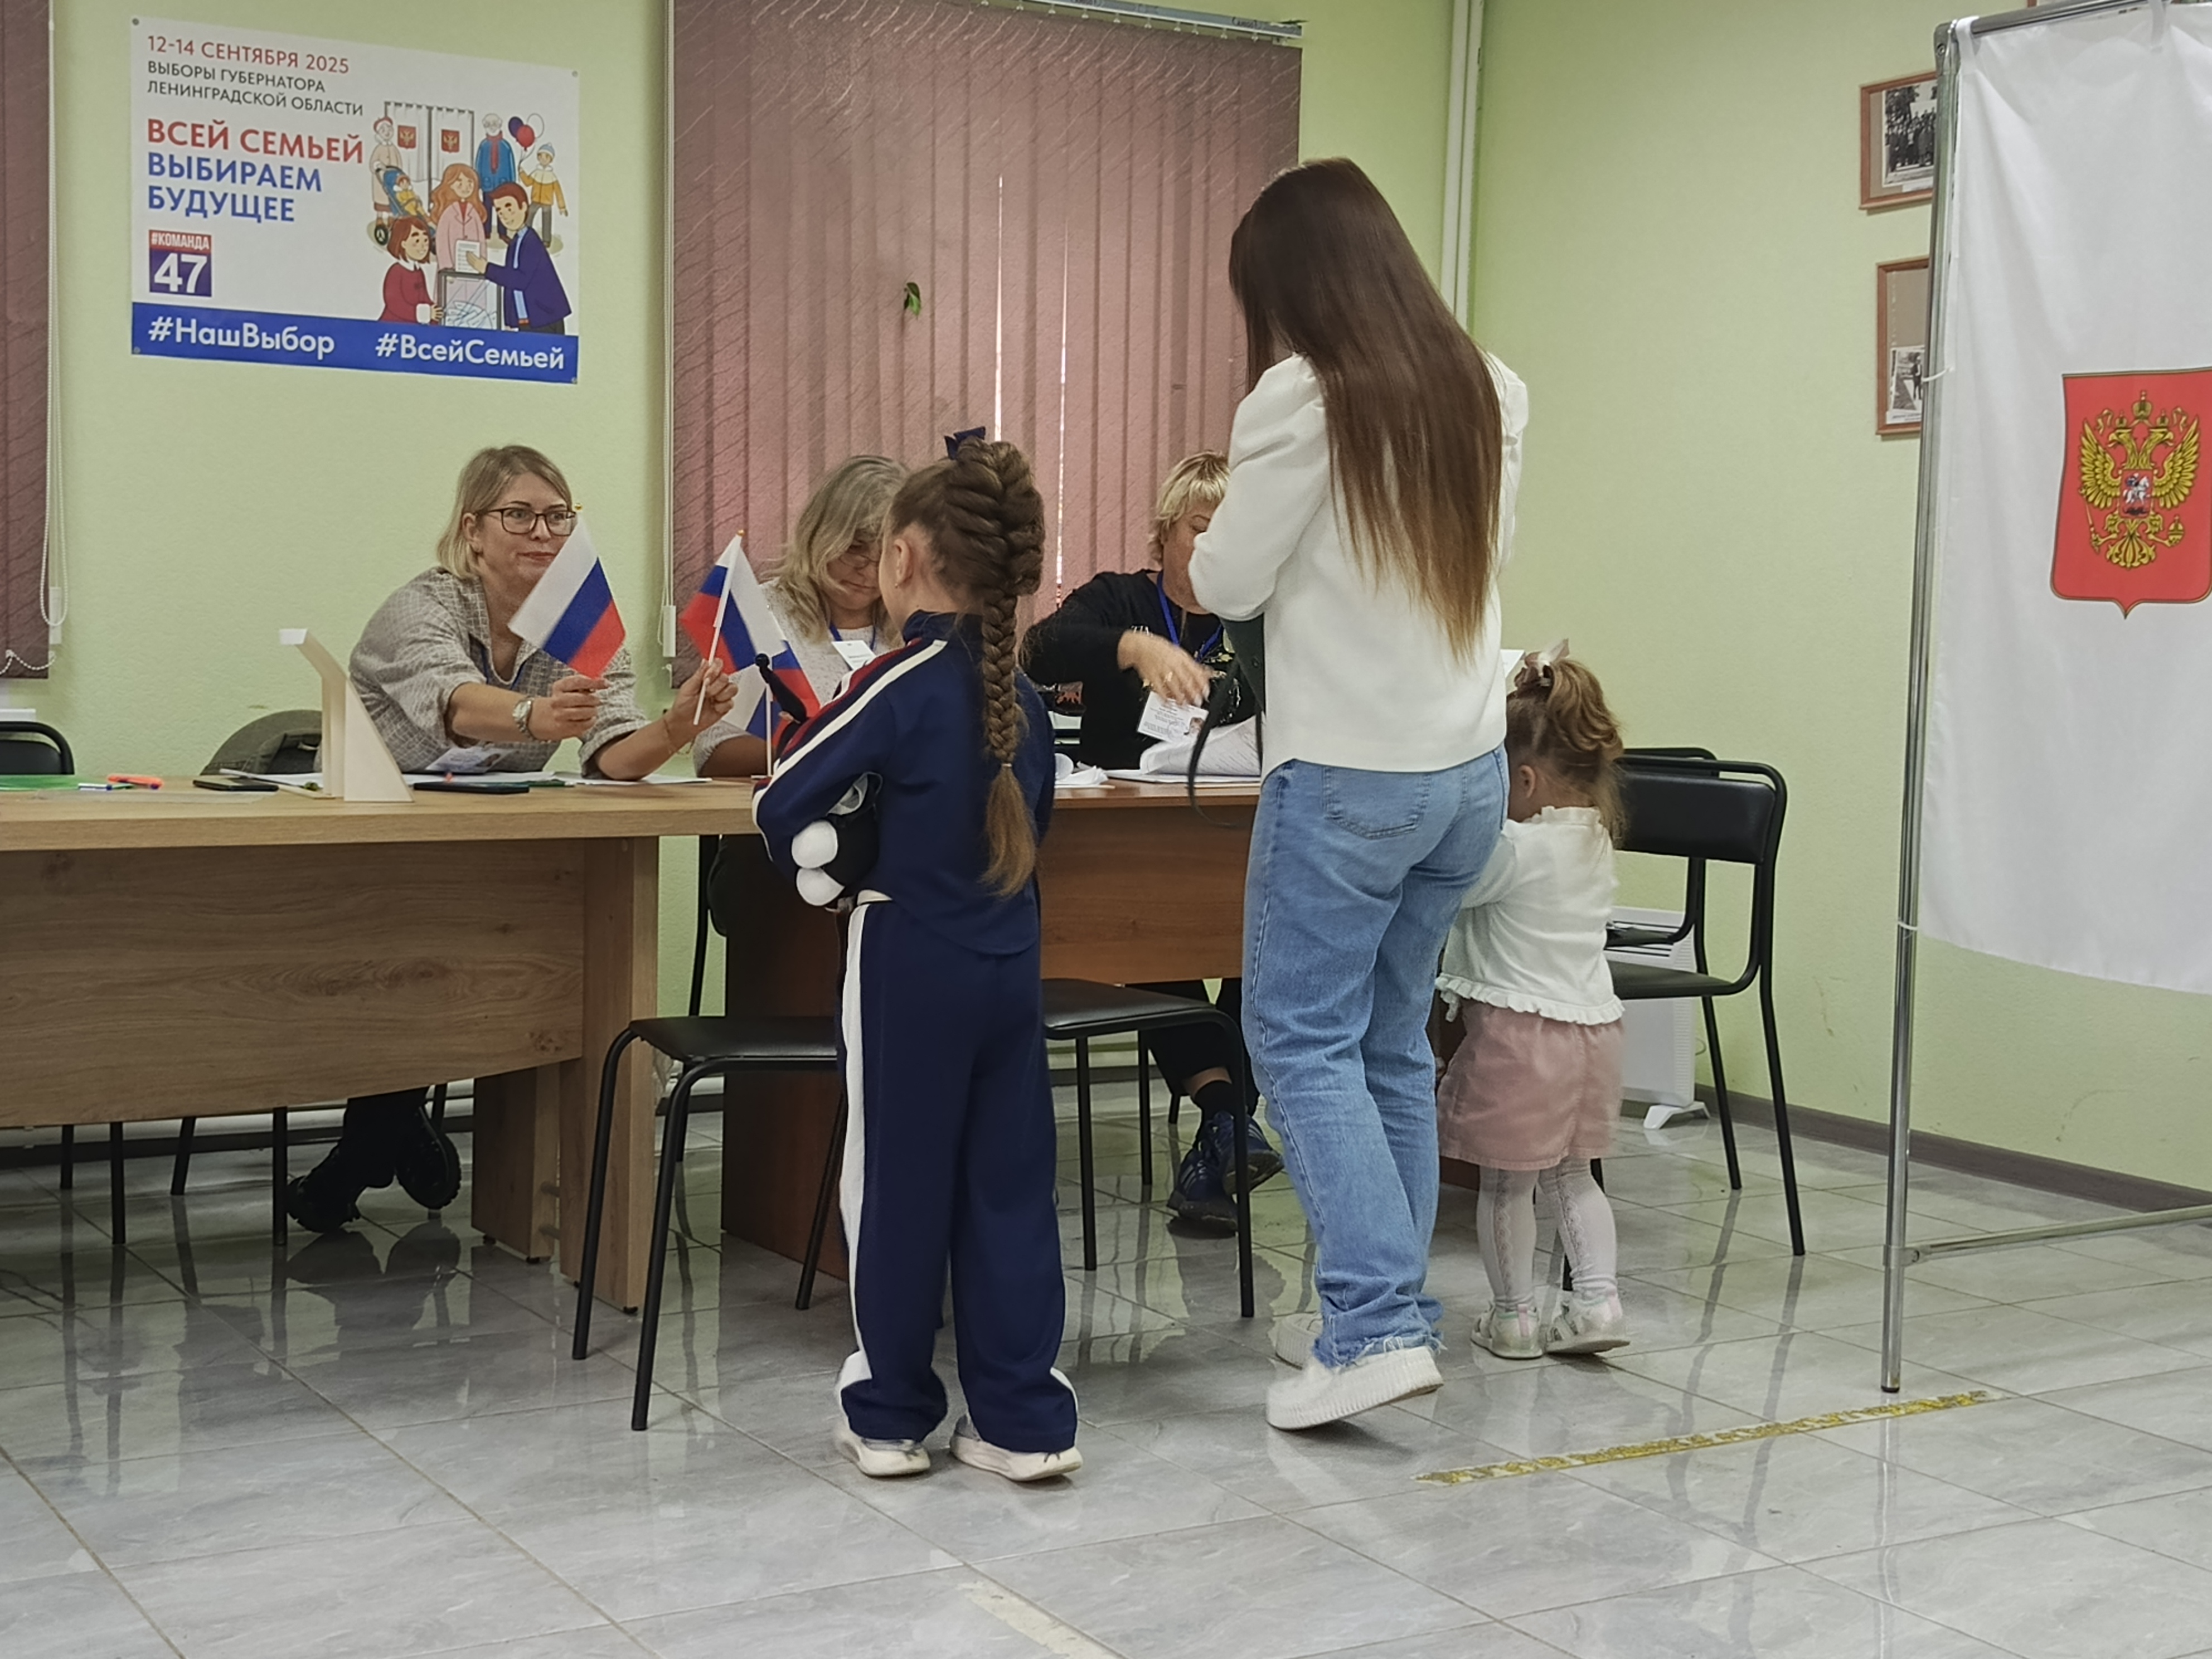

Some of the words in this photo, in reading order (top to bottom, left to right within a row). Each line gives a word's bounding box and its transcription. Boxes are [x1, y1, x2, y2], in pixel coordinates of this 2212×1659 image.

[148, 35, 195, 56] 12-14
[201, 42, 299, 68] СЕНТЯБРЯ
[305, 54, 350, 74] 2025
[148, 61, 215, 80] ВЫБОРЫ
[221, 69, 326, 93] ГУБЕРНАТОРА
[147, 80, 287, 108] ЛЕНИНГРАДСКОЙ
[291, 96, 363, 117] ОБЛАСТИ
[148, 118, 229, 150] ВСЕЙ
[240, 128, 363, 164] СЕМЬЕЙ
[148, 152, 322, 192] ВЫБИРАЕМ
[148, 185, 294, 223] БУДУЩЕЕ
[151, 231, 210, 250] #КОМАНДА
[154, 253, 208, 294] 47
[148, 316, 335, 361] #НашВыбор
[375, 333, 565, 370] #ВсейСемьей
